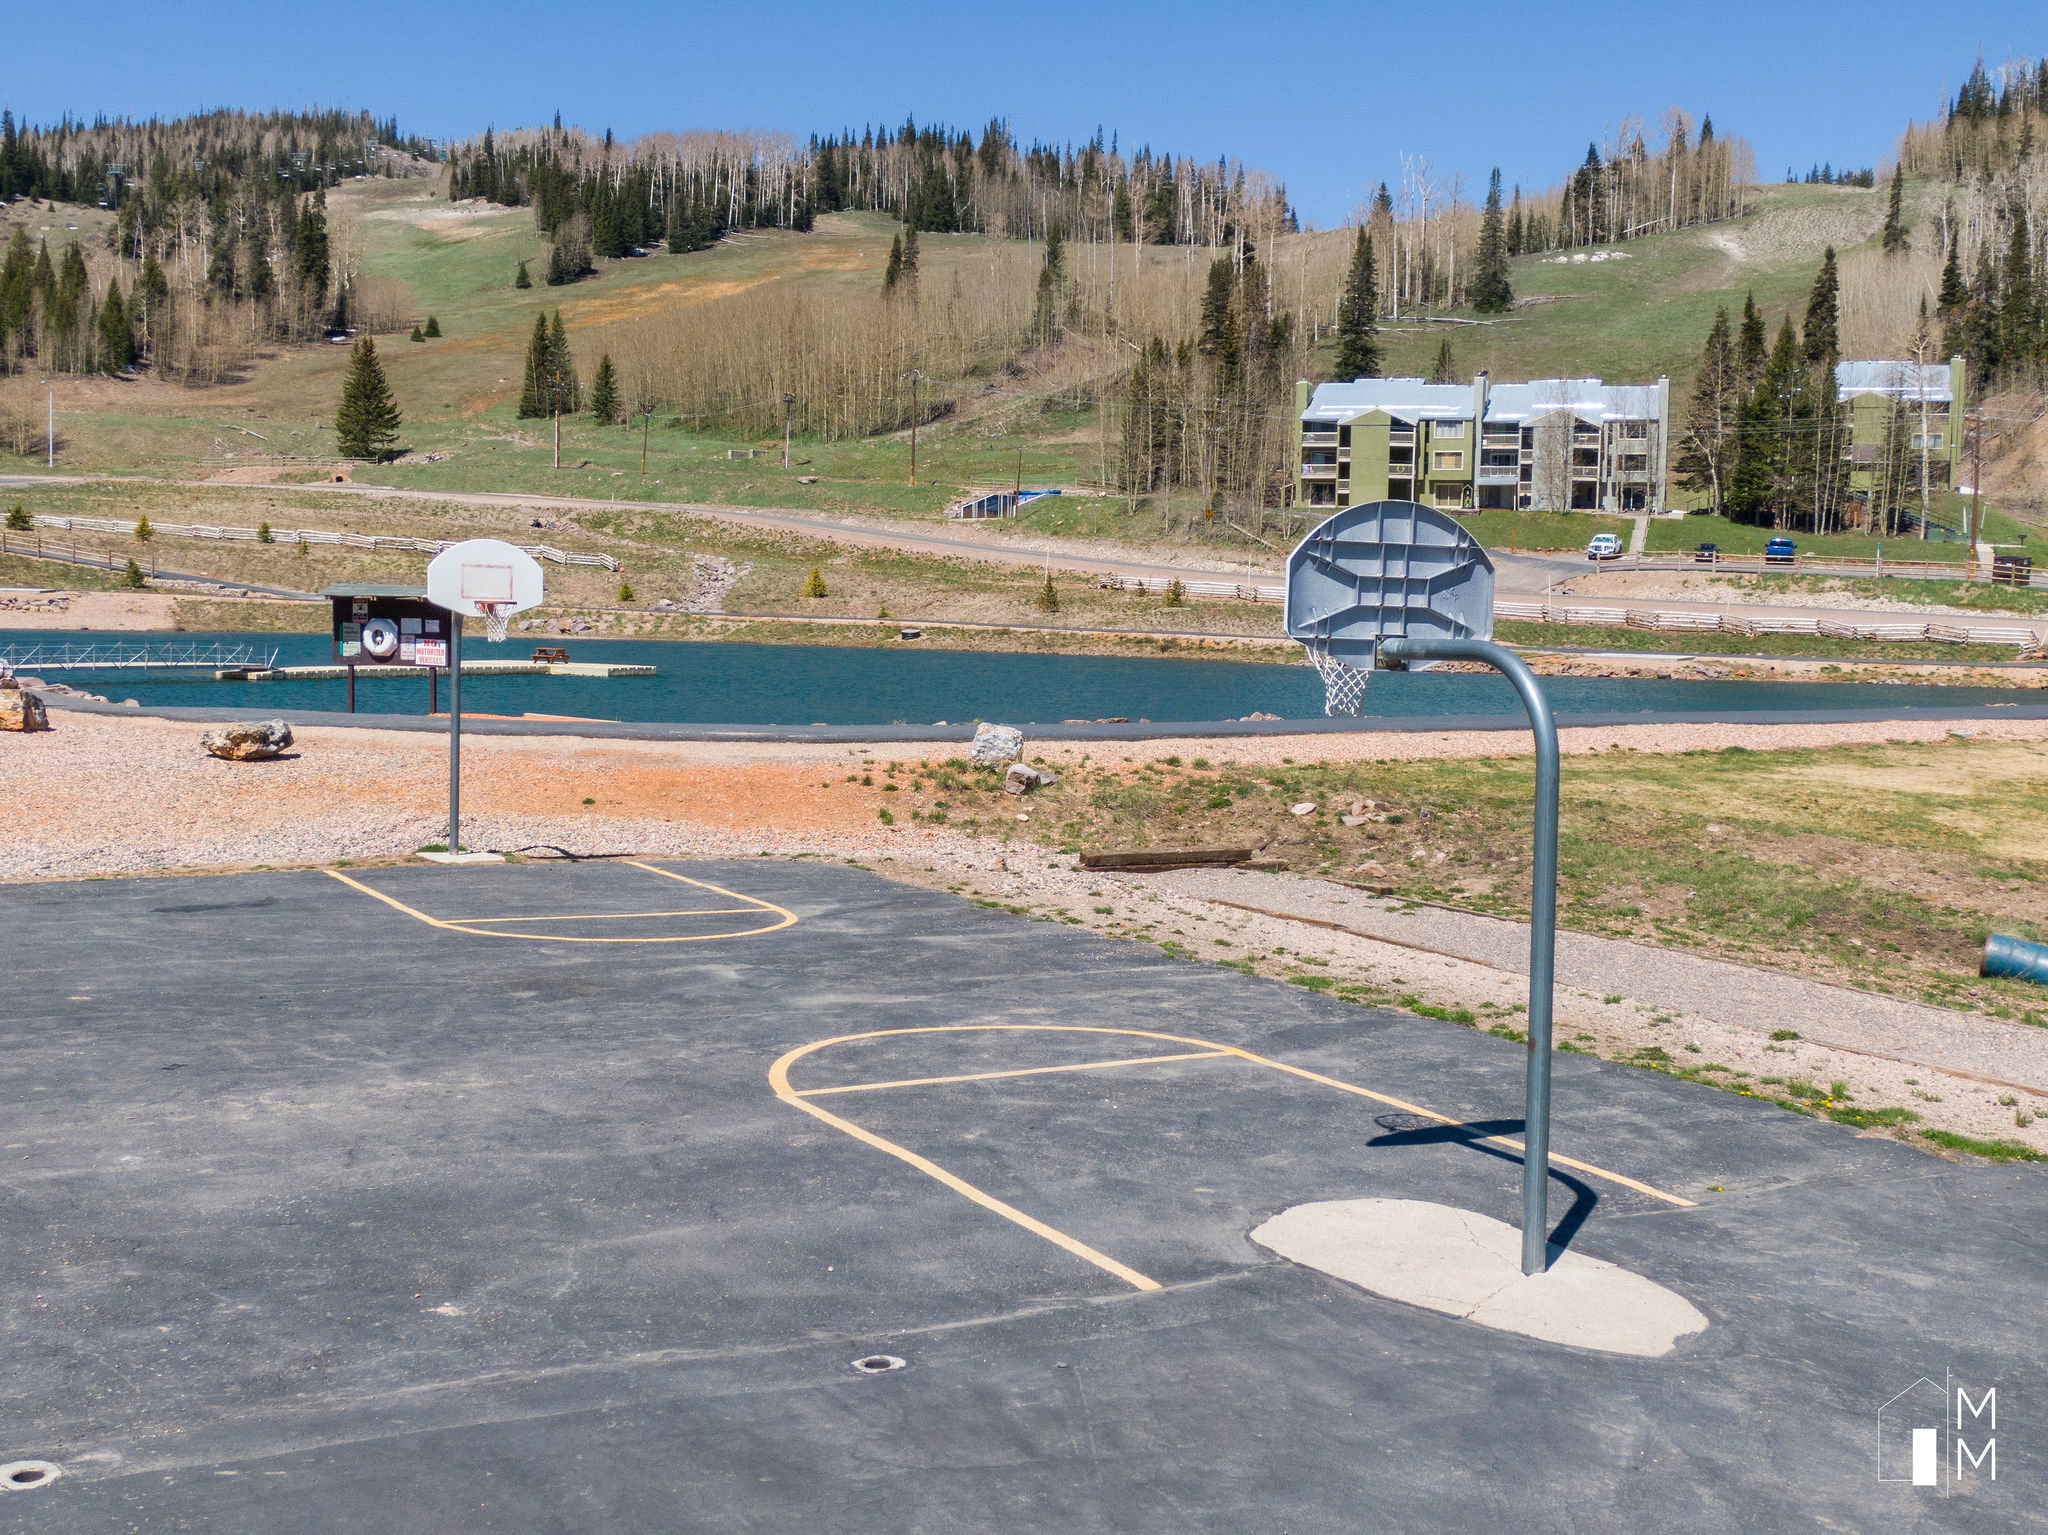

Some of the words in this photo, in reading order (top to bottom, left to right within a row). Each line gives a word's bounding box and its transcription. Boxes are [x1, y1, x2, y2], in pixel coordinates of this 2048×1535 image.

[423, 639, 437, 647] NO
[416, 648, 445, 656] MOTORIZED
[418, 656, 443, 665] VEHICLES
